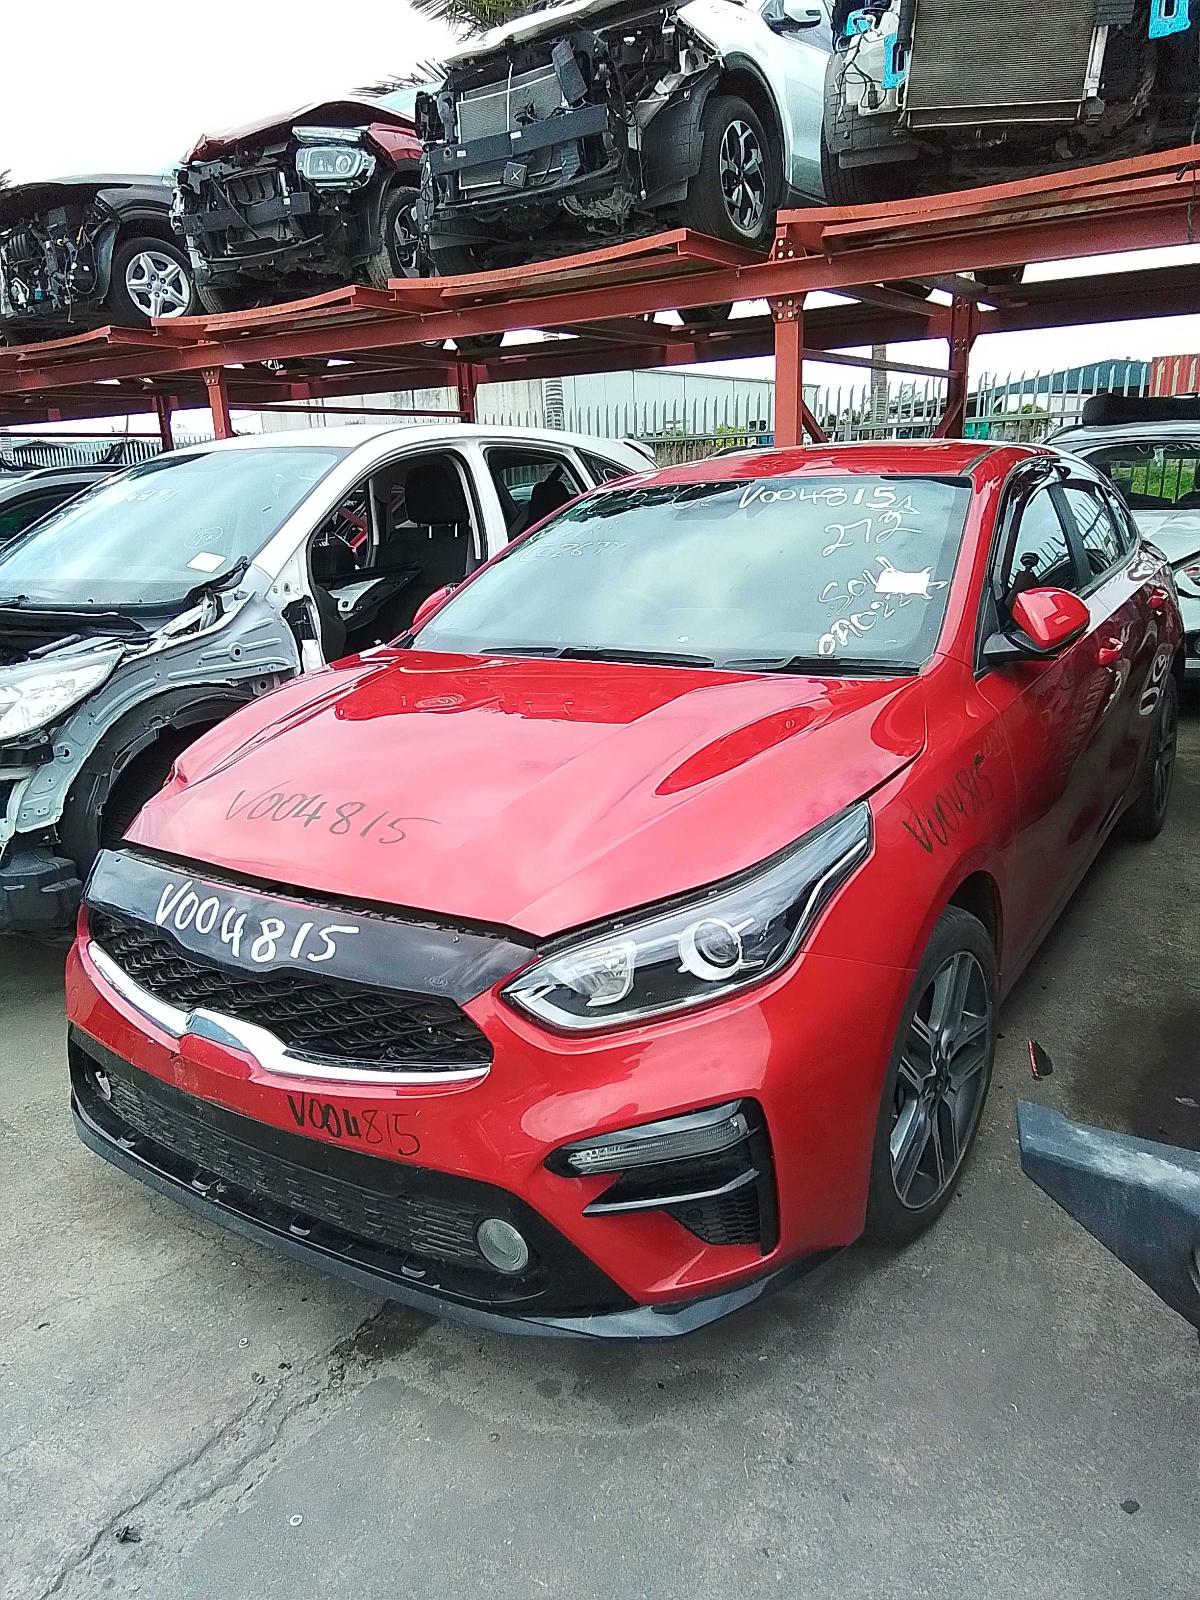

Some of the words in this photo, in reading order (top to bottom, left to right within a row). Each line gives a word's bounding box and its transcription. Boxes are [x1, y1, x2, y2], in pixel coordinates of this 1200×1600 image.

[738, 485, 897, 509] V004815
[225, 779, 442, 844] V004815
[155, 880, 360, 963] V004815
[287, 1092, 421, 1156] V004815
